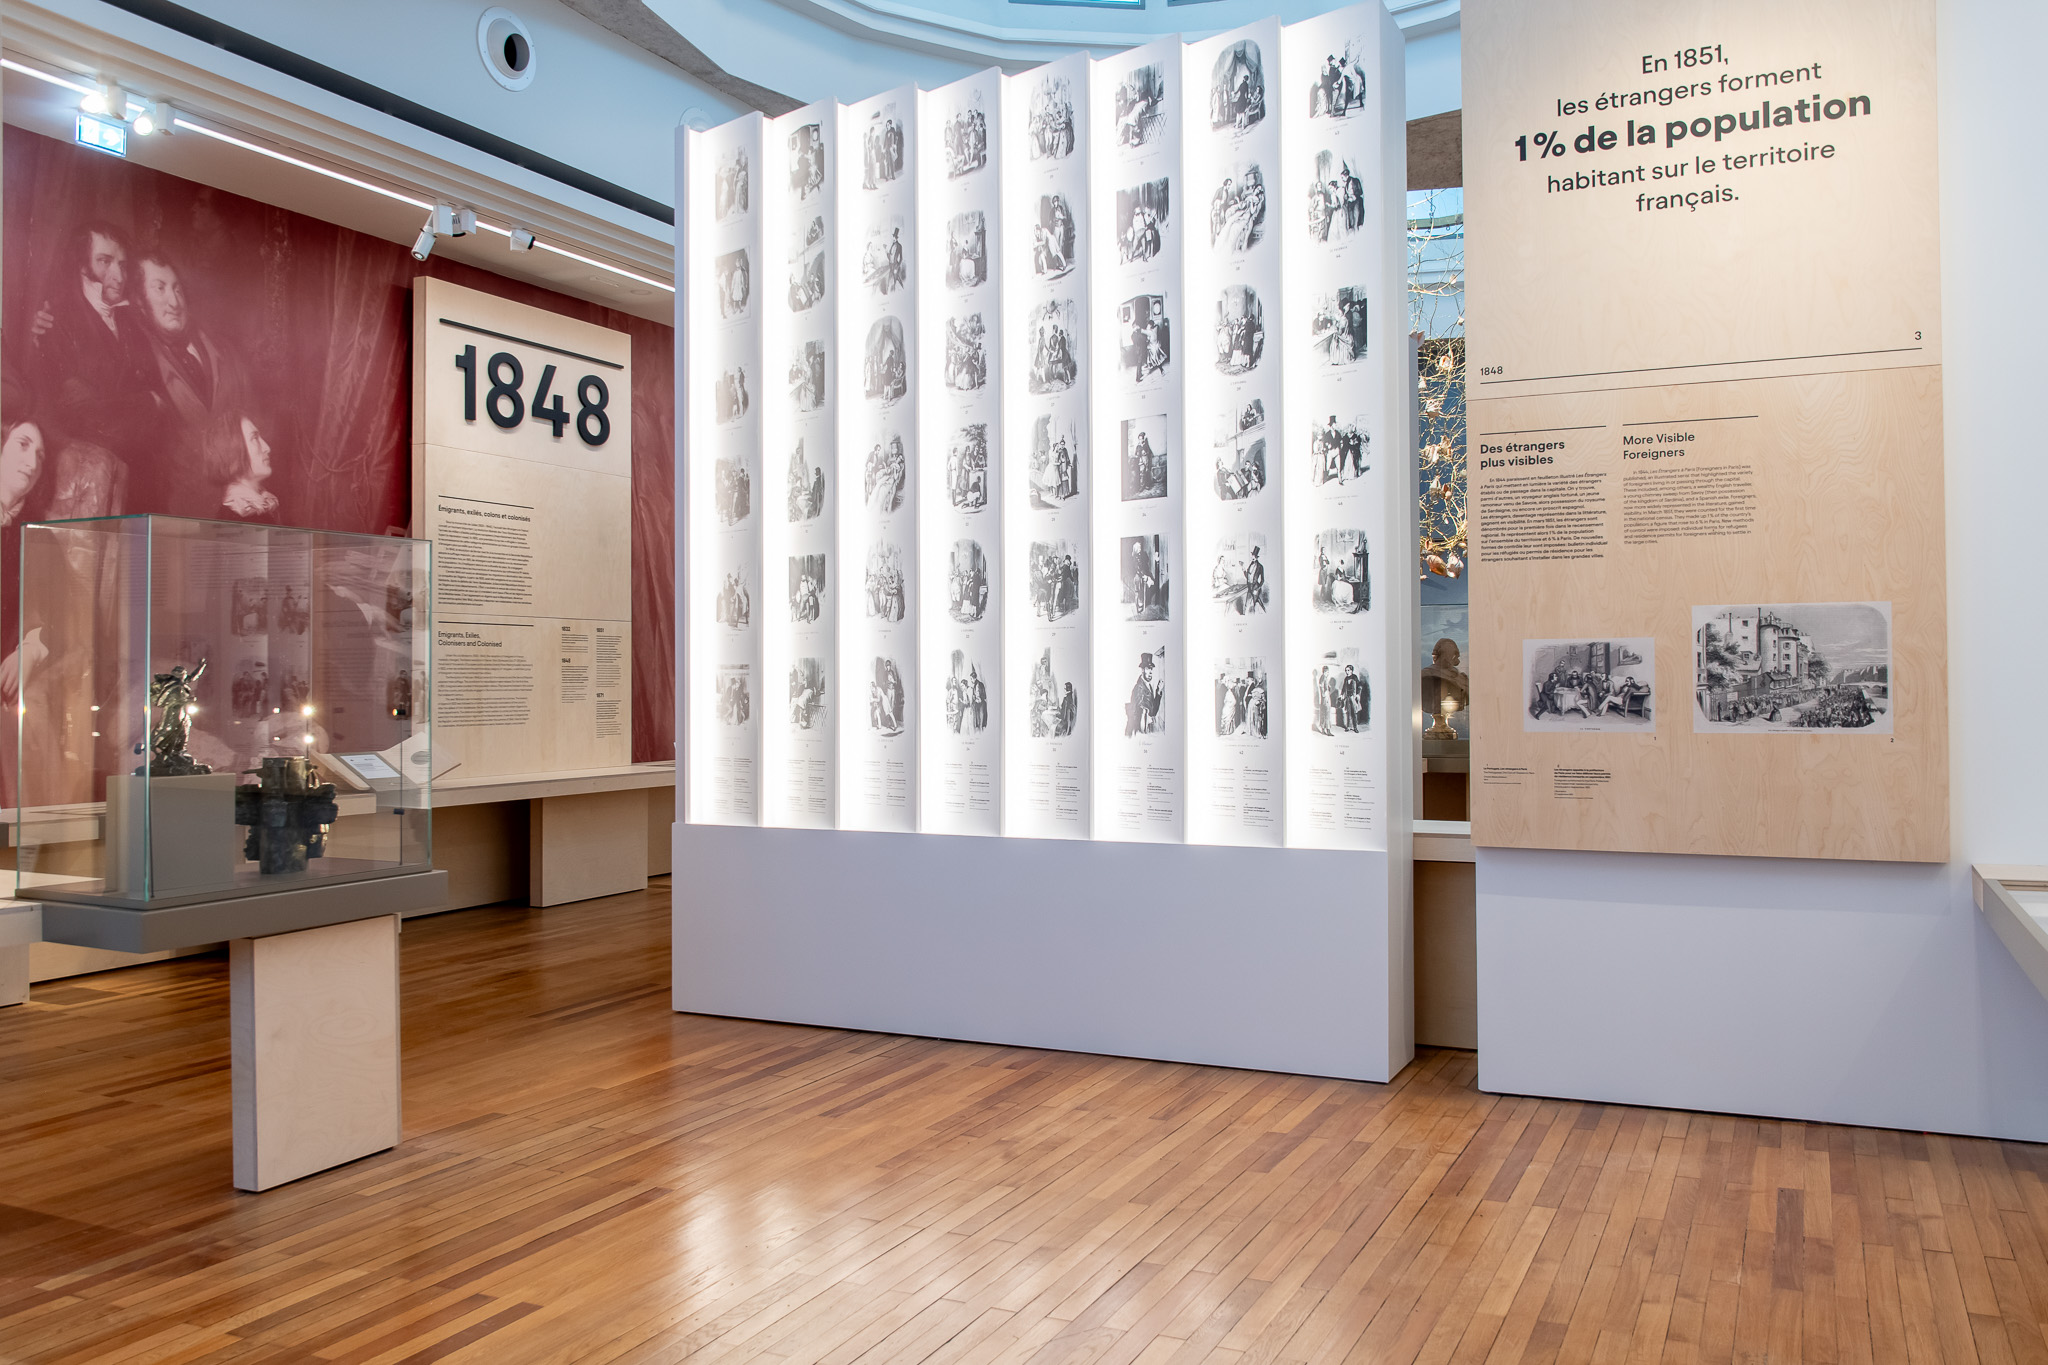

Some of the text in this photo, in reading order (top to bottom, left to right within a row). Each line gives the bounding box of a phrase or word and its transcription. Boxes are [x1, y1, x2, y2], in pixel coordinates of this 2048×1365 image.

[1642, 44, 1729, 74] En 1851,
[1557, 62, 1822, 116] les étrangers forment
[1574, 126, 1618, 153] de
[1627, 120, 1656, 146] la
[1665, 94, 1872, 148] population
[1547, 142, 1835, 193] habitant sur le territoire
[1636, 184, 1739, 213] français.
[1914, 331, 1922, 340] 3
[1480, 366, 1503, 376] 1848
[456, 344, 610, 446] 1848
[1623, 432, 1695, 445] More Visible
[1480, 442, 1565, 454] Des étrangers
[1623, 449, 1685, 460] Foreigners
[1480, 455, 1553, 471] plus visibles
[438, 504, 466, 514] Émigrants,
[467, 508, 483, 517] exilés,
[438, 631, 465, 639] Emigrants,
